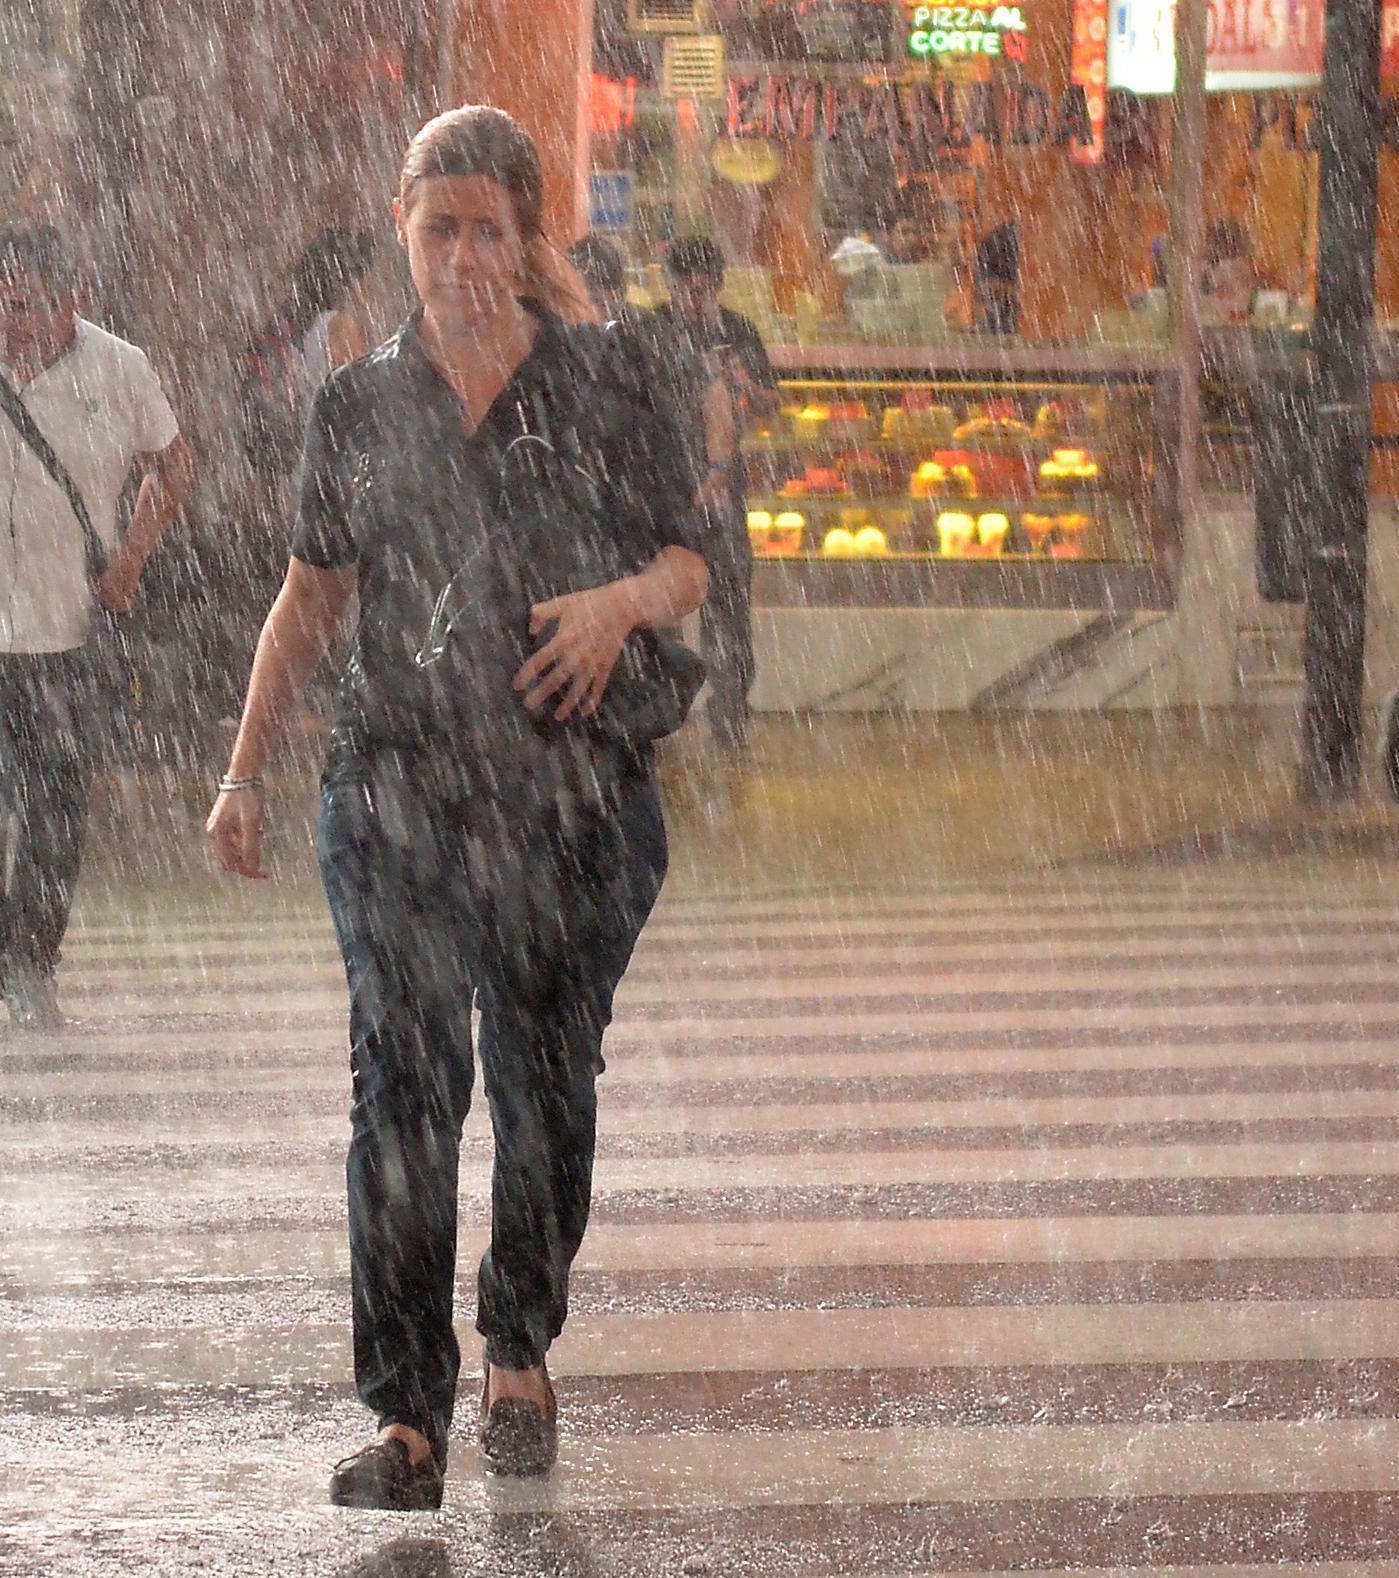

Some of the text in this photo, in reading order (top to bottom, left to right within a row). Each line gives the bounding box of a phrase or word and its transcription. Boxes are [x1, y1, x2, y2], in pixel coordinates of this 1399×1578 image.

[915, 6, 1027, 31] PIZZA AL
[910, 30, 1000, 54] CORTE
